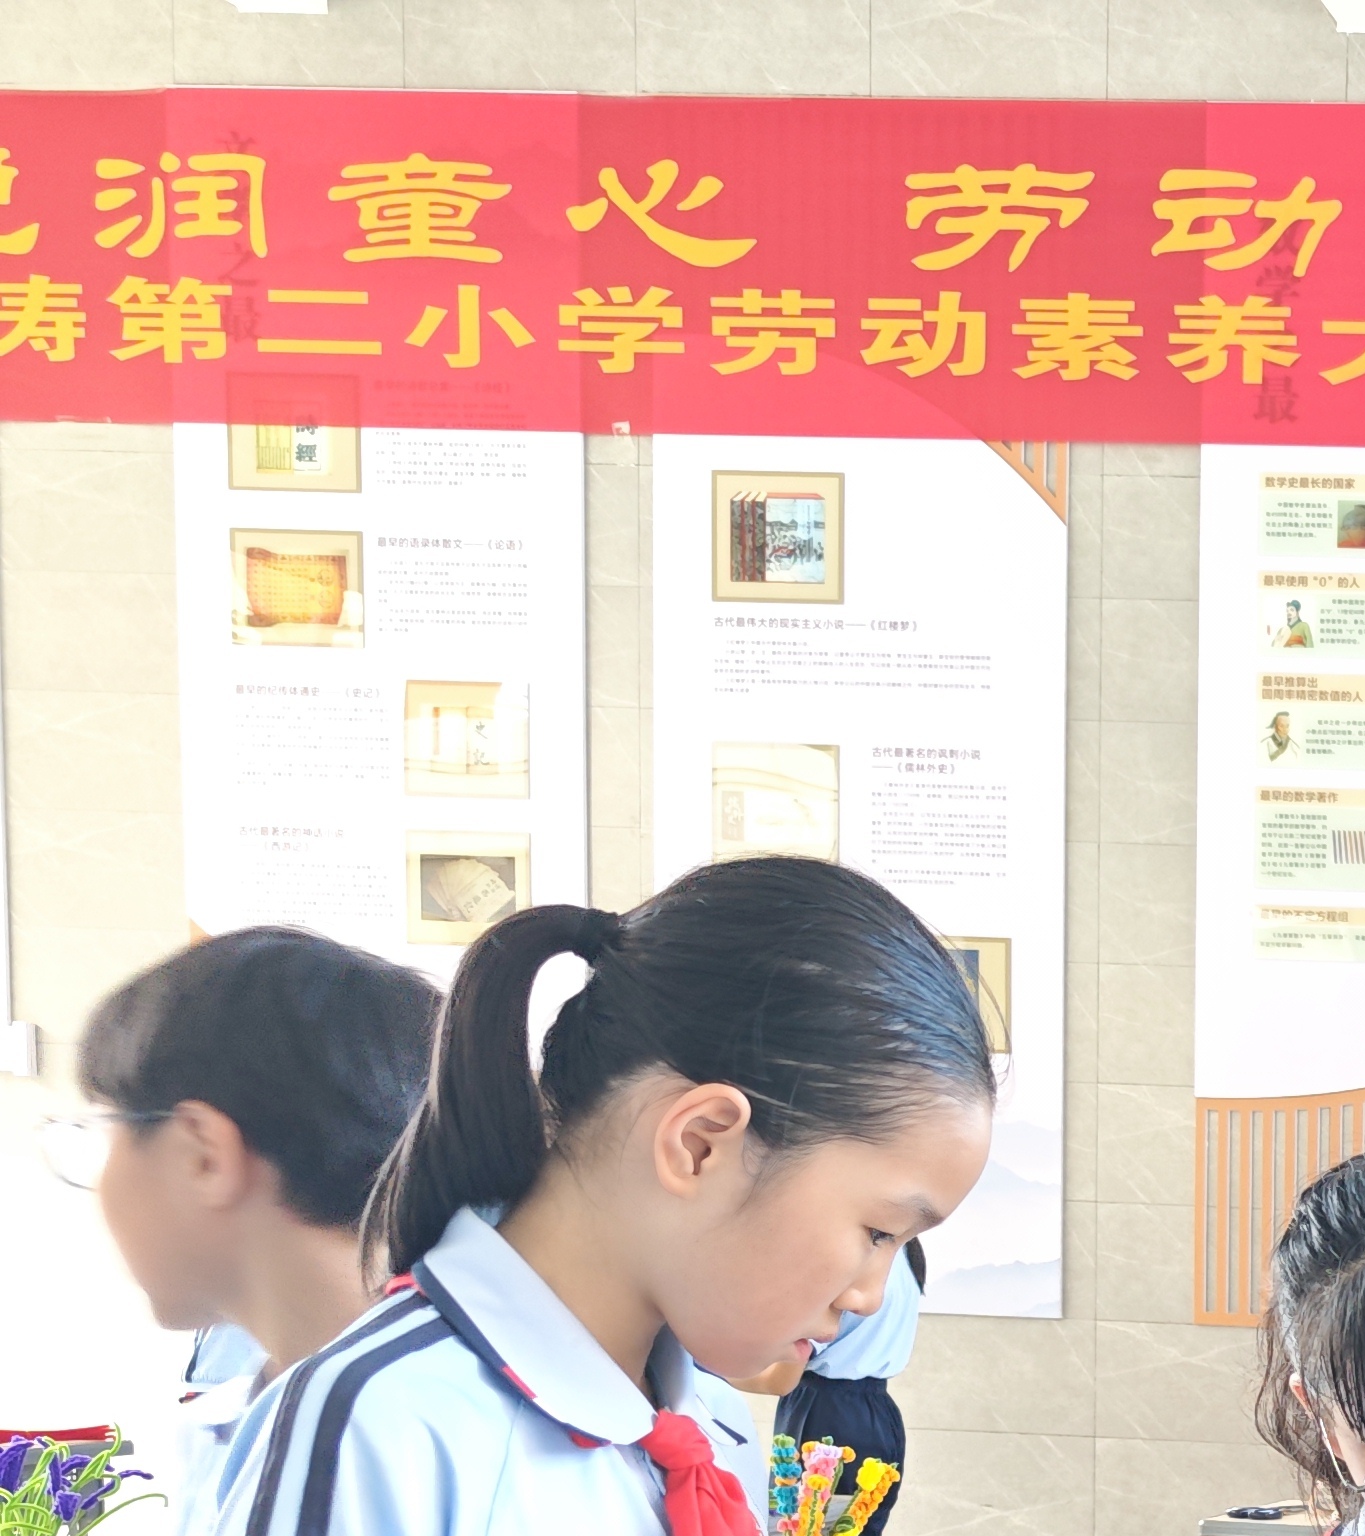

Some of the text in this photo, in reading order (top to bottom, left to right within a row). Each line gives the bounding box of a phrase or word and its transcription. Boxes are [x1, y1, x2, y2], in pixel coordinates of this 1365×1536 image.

[0, 147, 757, 267] 润童心
[1264, 475, 1356, 491] 数学史最长的国家
[1261, 675, 1318, 689] 最早推算出
[1261, 689, 1364, 703] 圆周率精密数值的人
[1259, 790, 1339, 804] 最早的数学著作
